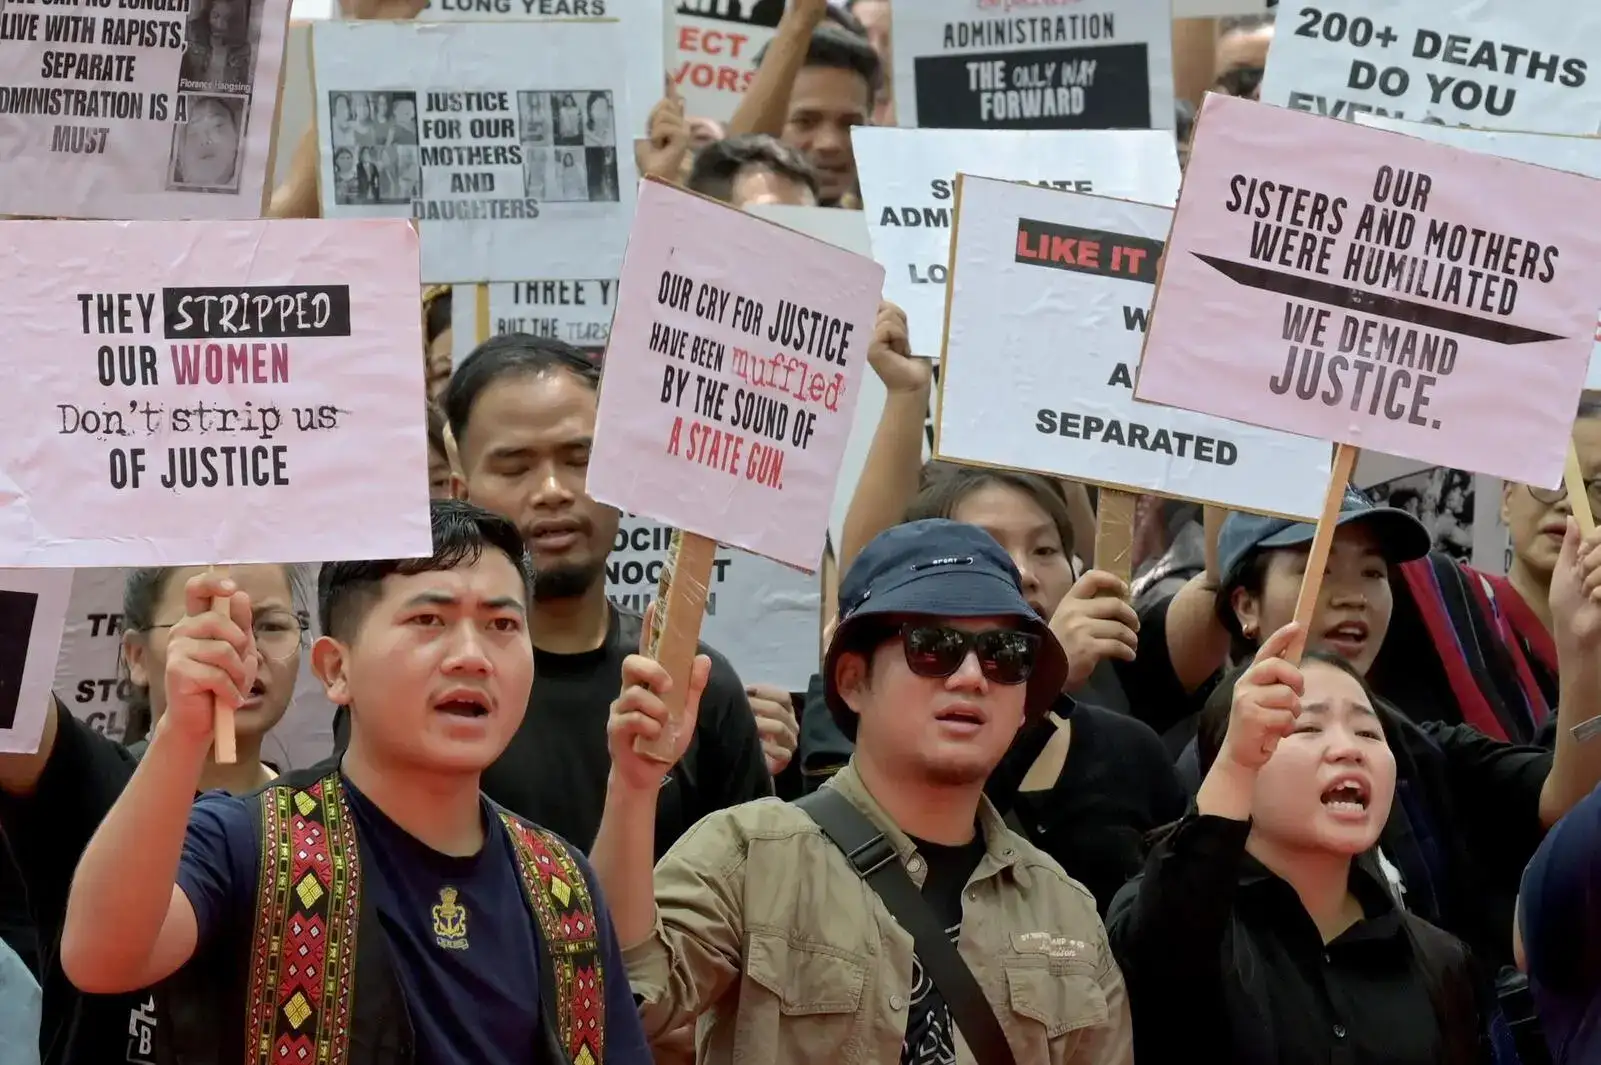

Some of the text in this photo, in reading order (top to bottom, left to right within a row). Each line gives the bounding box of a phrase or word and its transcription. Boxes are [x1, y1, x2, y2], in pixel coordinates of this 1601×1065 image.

[522, 0, 605, 16] YEARS
[1, 13, 186, 51] LIVE WITH RAPISTS,
[943, 13, 1115, 48] ADMINISTRATION
[1295, 7, 1588, 88] 200+ DEATHS
[41, 51, 136, 82] SEPARATE
[966, 58, 1098, 91] THE ONLY WAY
[425, 92, 509, 112] JUSTICE
[980, 86, 1085, 121] FORWARD
[1348, 59, 1516, 117] DO YOU
[149, 93, 168, 121] IS
[174, 95, 187, 122] A
[51, 125, 110, 154] MUST
[423, 118, 515, 140] FOR OUR
[421, 146, 522, 167] MOTHERS
[451, 173, 495, 193] AND
[1373, 166, 1432, 212] OUR
[412, 199, 540, 220] DAUGHTERS
[1226, 174, 1559, 284] SISTERS AND MOTHERS
[1017, 230, 1147, 274] LIKE IT
[1250, 222, 1518, 316] WERE HUMILIATED
[513, 280, 585, 305] THREE
[77, 291, 331, 335] THEY STRIPPED
[532, 318, 559, 338] THE
[658, 271, 854, 366] OUR CRY FOR JUSTICE
[1282, 302, 1458, 376] WE DEMAND
[98, 343, 289, 387] OUR WOMEN
[649, 322, 845, 413] HAVE BEEN muffled
[1108, 363, 1138, 389] A
[1269, 346, 1442, 429] JUSTICE.
[57, 400, 342, 439] Don't strip us
[660, 364, 817, 450] BY THE SOUND OF
[667, 416, 785, 490] A STATE GUN.
[1036, 408, 1237, 466] SEPARATED
[109, 445, 289, 489] OF JUSTICE
[606, 559, 731, 584] NOCT
